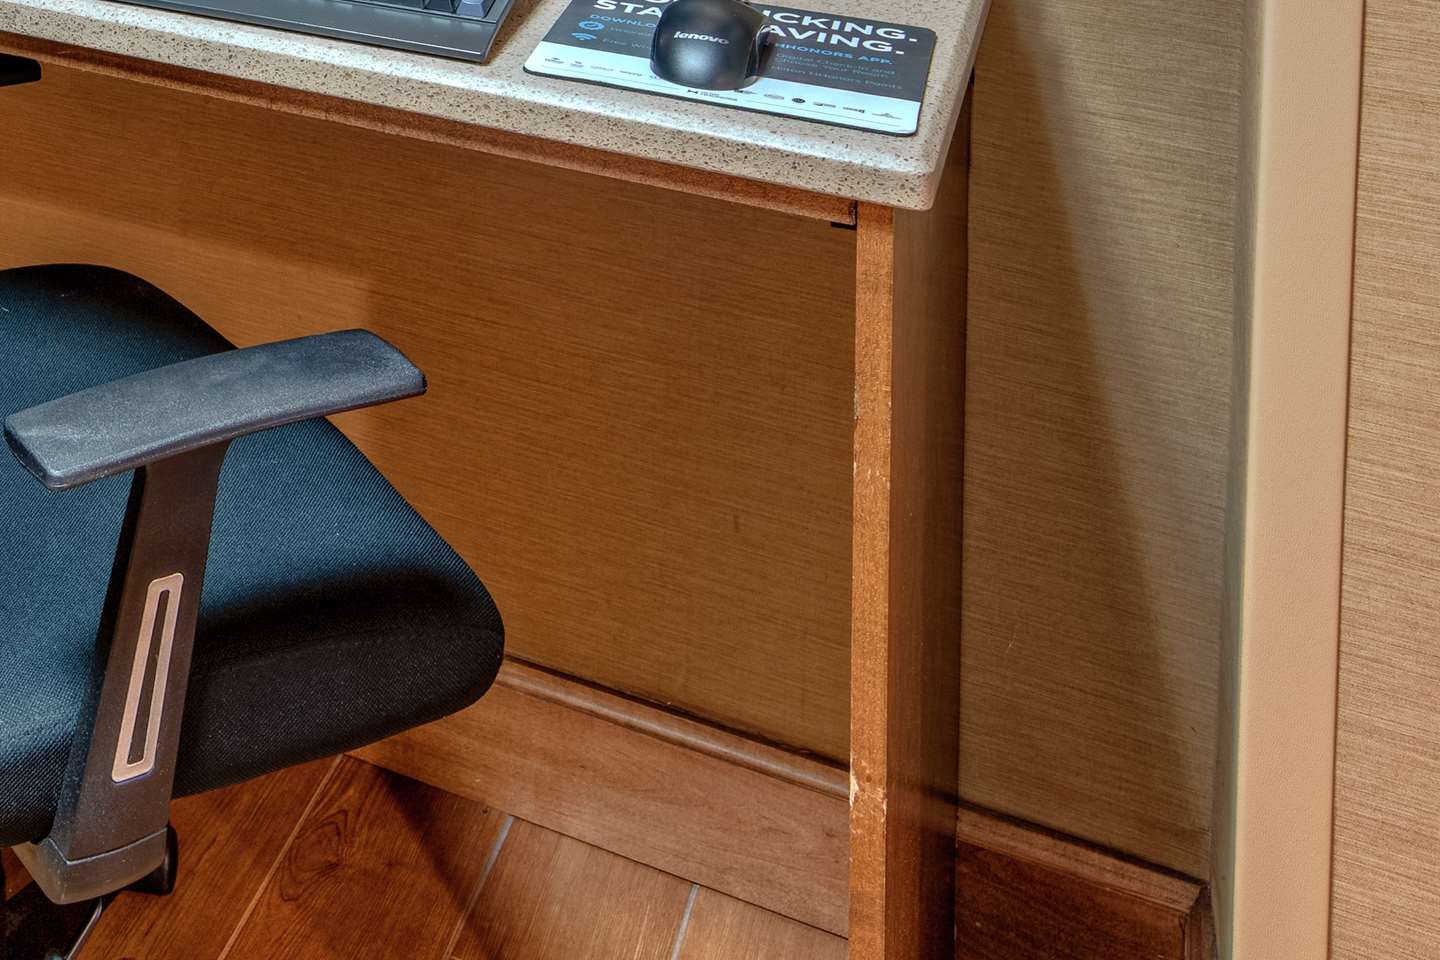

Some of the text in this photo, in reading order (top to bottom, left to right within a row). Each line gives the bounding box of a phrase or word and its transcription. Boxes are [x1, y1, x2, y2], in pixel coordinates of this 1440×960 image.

[589, 14, 657, 28] DOWNLO
[593, 0, 905, 55] STA AVING.
[762, 10, 917, 42] CKING.
[673, 31, 730, 45] lenovo
